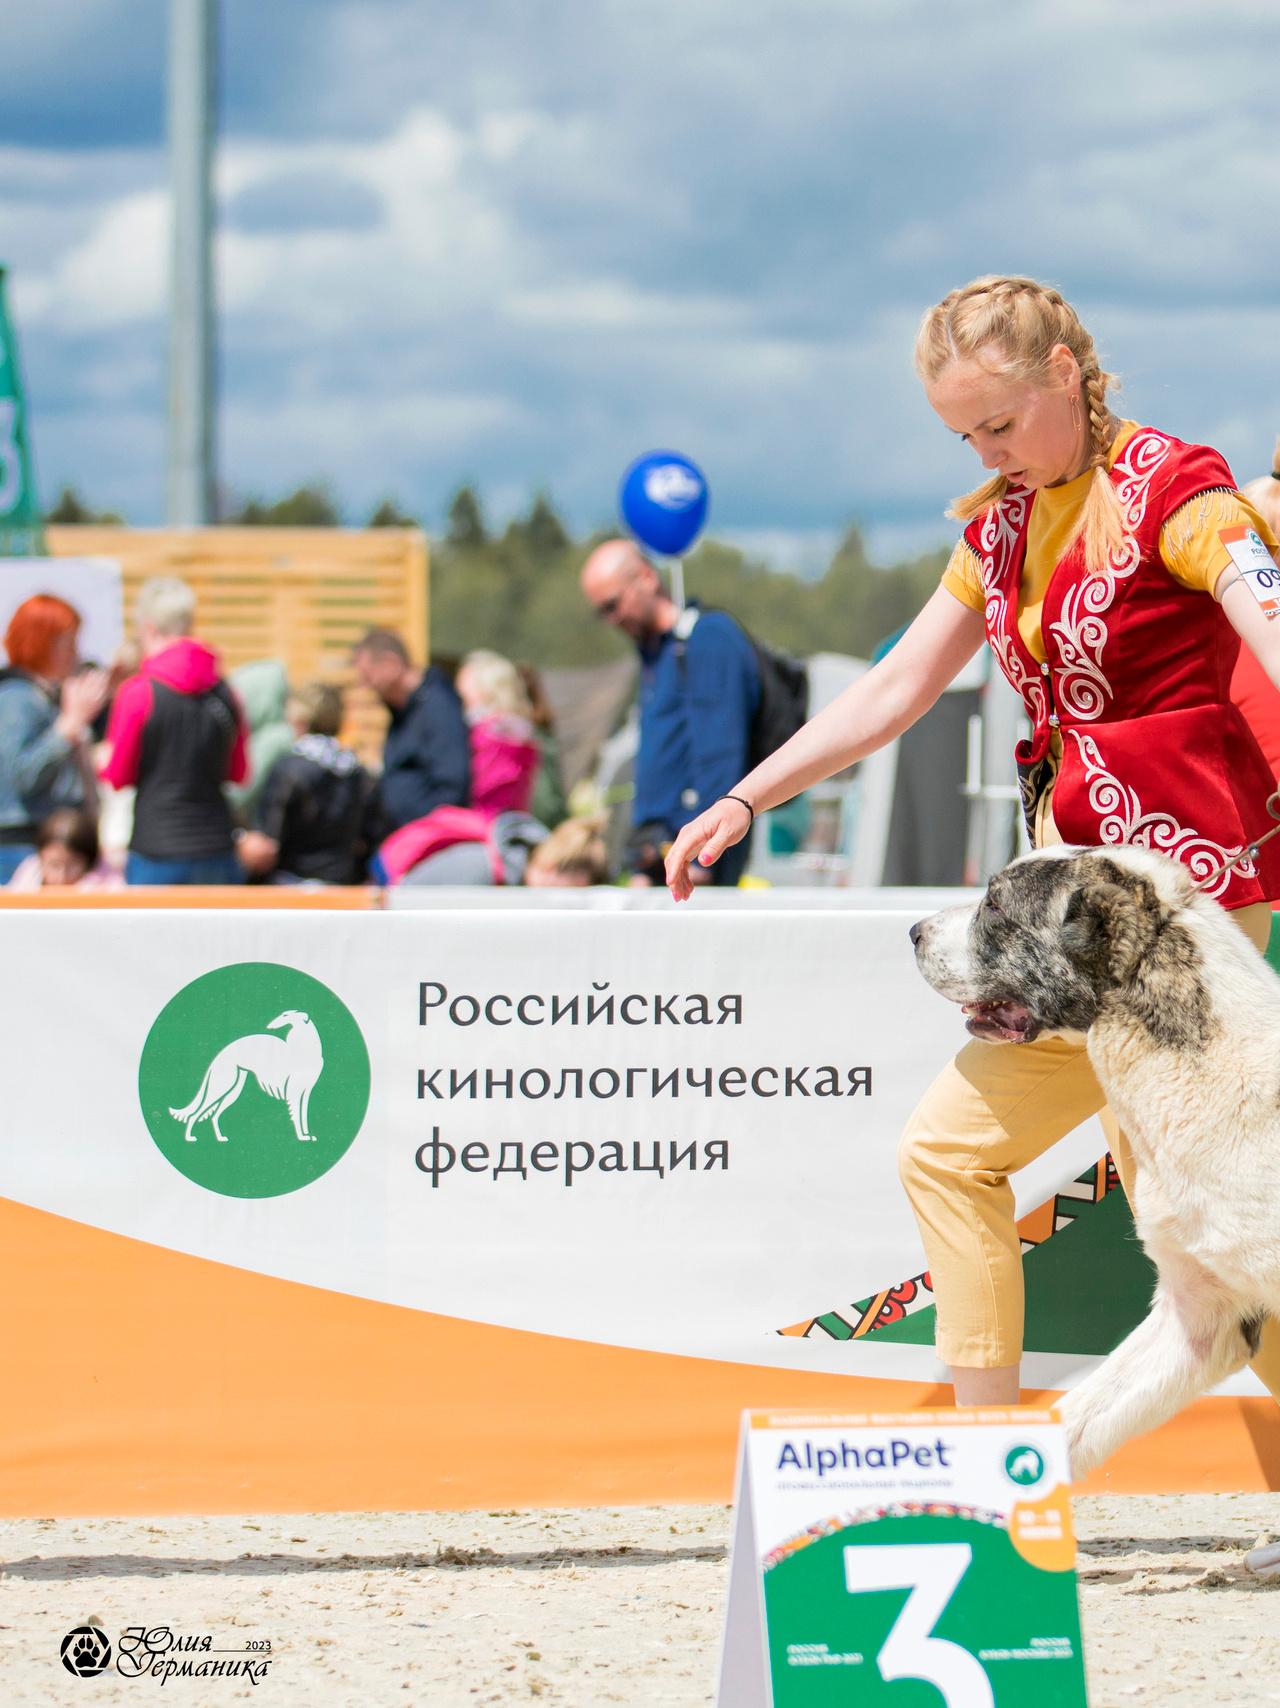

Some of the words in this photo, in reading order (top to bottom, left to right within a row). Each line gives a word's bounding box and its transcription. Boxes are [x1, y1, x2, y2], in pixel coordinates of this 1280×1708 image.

[418, 981, 743, 1026] Российская
[416, 1064, 873, 1100] кинологическая
[414, 1126, 730, 1188] федерация
[777, 1439, 951, 1477] AlphaPet
[842, 1542, 996, 1708] 3
